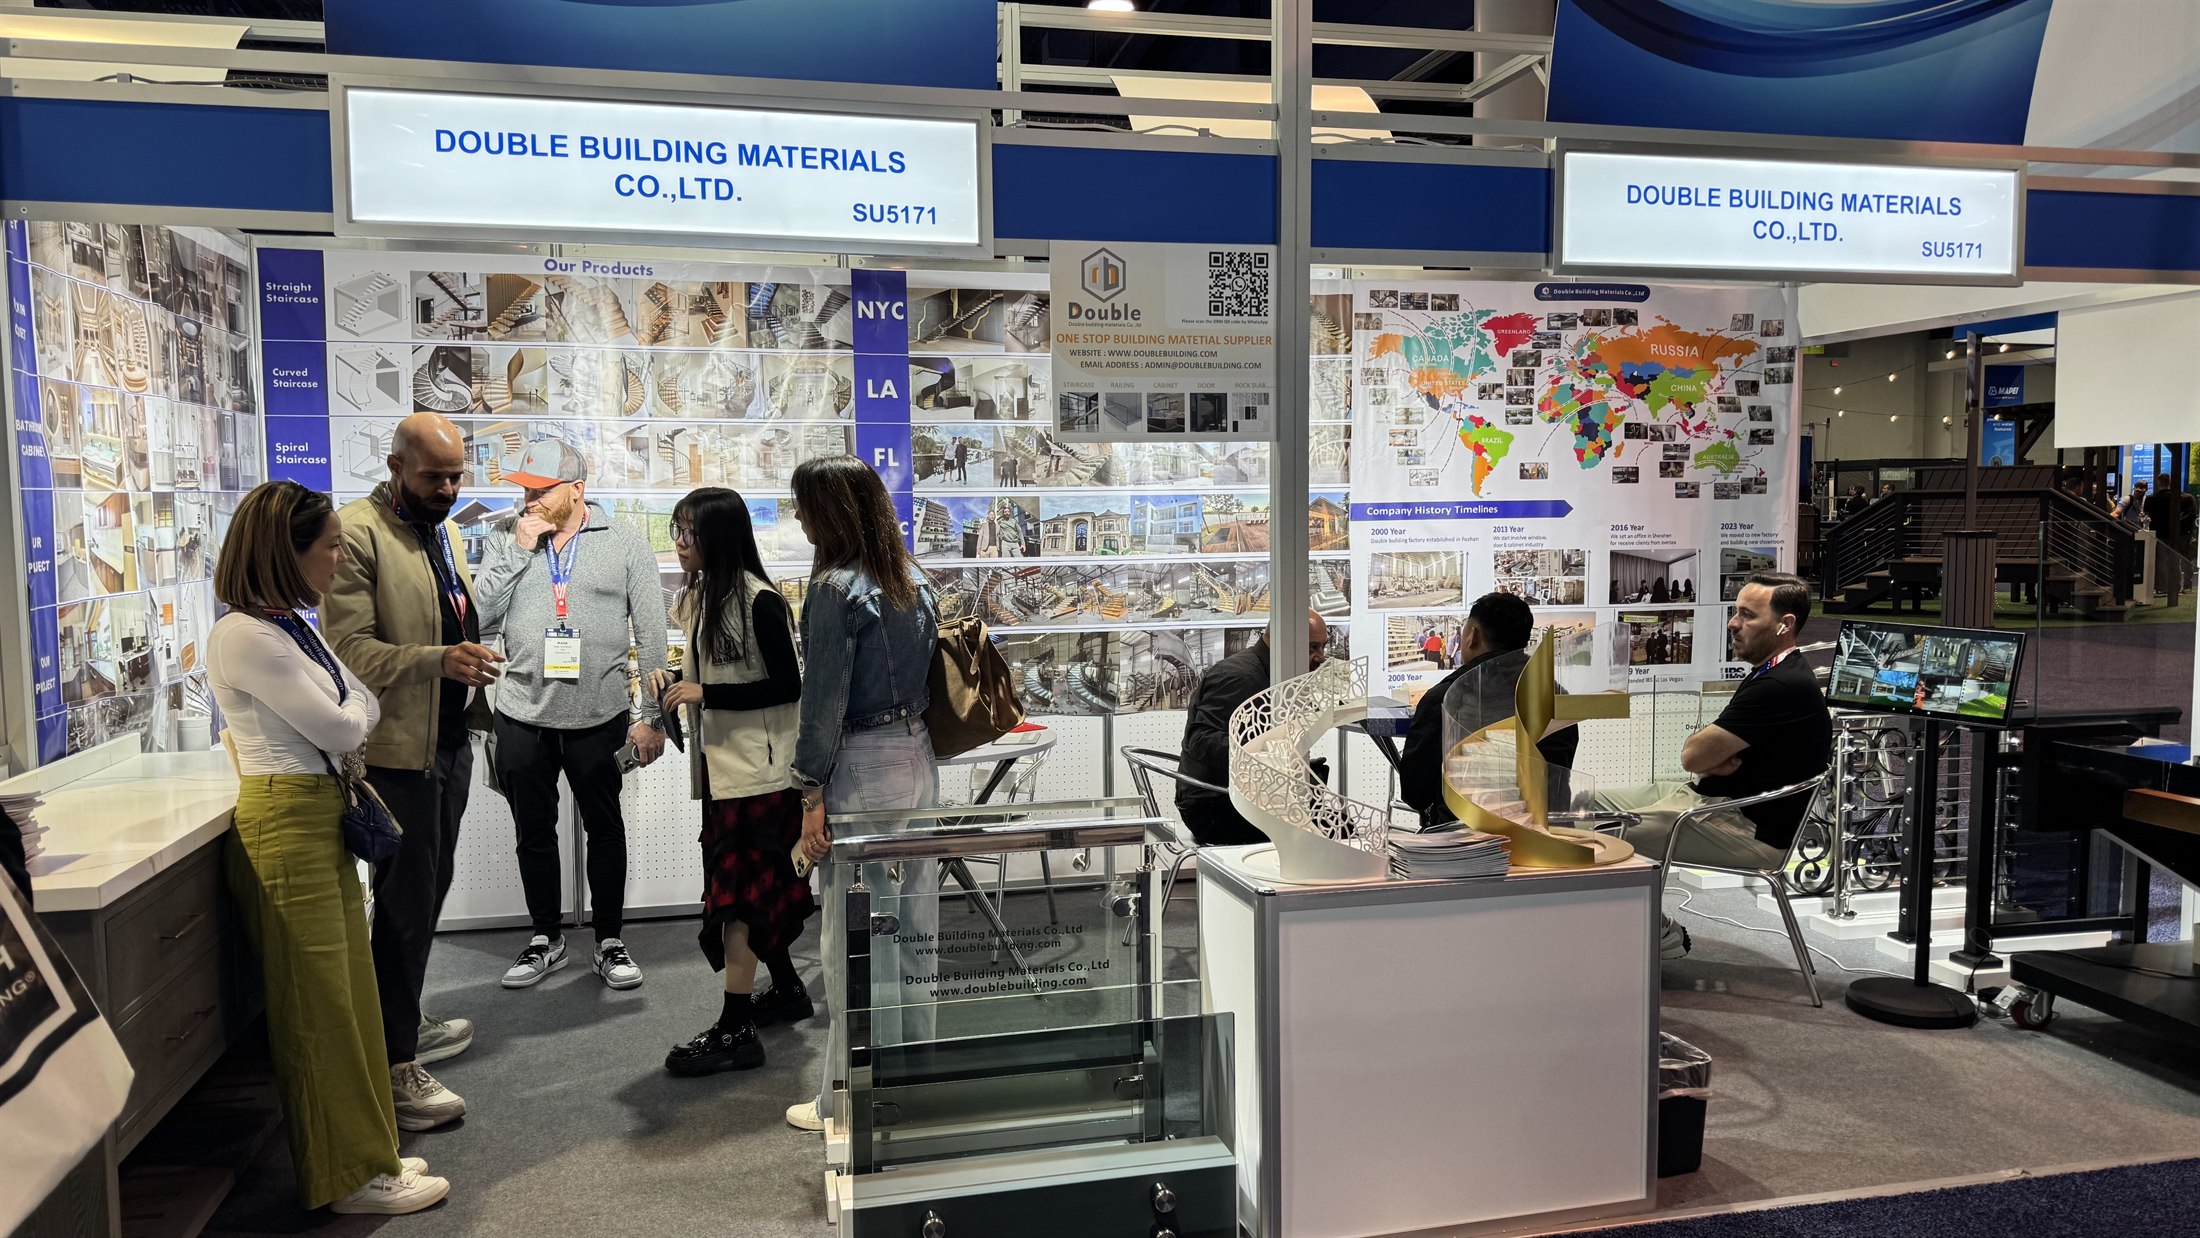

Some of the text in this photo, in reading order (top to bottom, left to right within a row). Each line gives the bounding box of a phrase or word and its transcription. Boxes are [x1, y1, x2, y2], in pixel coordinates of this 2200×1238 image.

[435, 129, 906, 174] DOUBLE BUILDING MATERIALS
[614, 173, 743, 204] CO.,LTD.
[1627, 184, 1961, 216] DOUBLE BUILDING MATERIALS
[852, 203, 938, 226] SU5171
[1753, 220, 1844, 244] CO.,LTD.
[1922, 241, 1982, 259] SU5171
[544, 258, 654, 277] Our Products
[266, 282, 312, 293] Straight
[266, 294, 319, 304] Staircase
[858, 301, 904, 320] NYC
[1068, 302, 1142, 321] Double
[1056, 333, 1272, 346] ONE STOP BUILDING MATETIAL SUPPLIER
[1108, 350, 1218, 358] WWW.DOUBLEBUILDING.COM
[1650, 344, 1699, 358] RUSSIA
[272, 368, 308, 377] Curved
[1144, 362, 1262, 370] ADMIN@DOUBLEBUILDING.COM
[273, 380, 318, 388] Staircase
[867, 379, 898, 399] LA
[1998, 386, 2020, 395] MAPEI
[275, 442, 309, 454] Spiral
[276, 455, 328, 465] Staircase
[874, 448, 899, 467] FL
[1366, 505, 1498, 516] Company History Timelines
[1371, 528, 1388, 536] 2000
[1388, 674, 1405, 682] 2008
[893, 925, 1083, 944] Double Building Materials Co.,Ltd
[916, 940, 1061, 956] www.doublebuilding.com
[905, 959, 1110, 986] Double Building Materials Co.,Ltd
[930, 976, 1087, 997] www.doublebuilding.com
